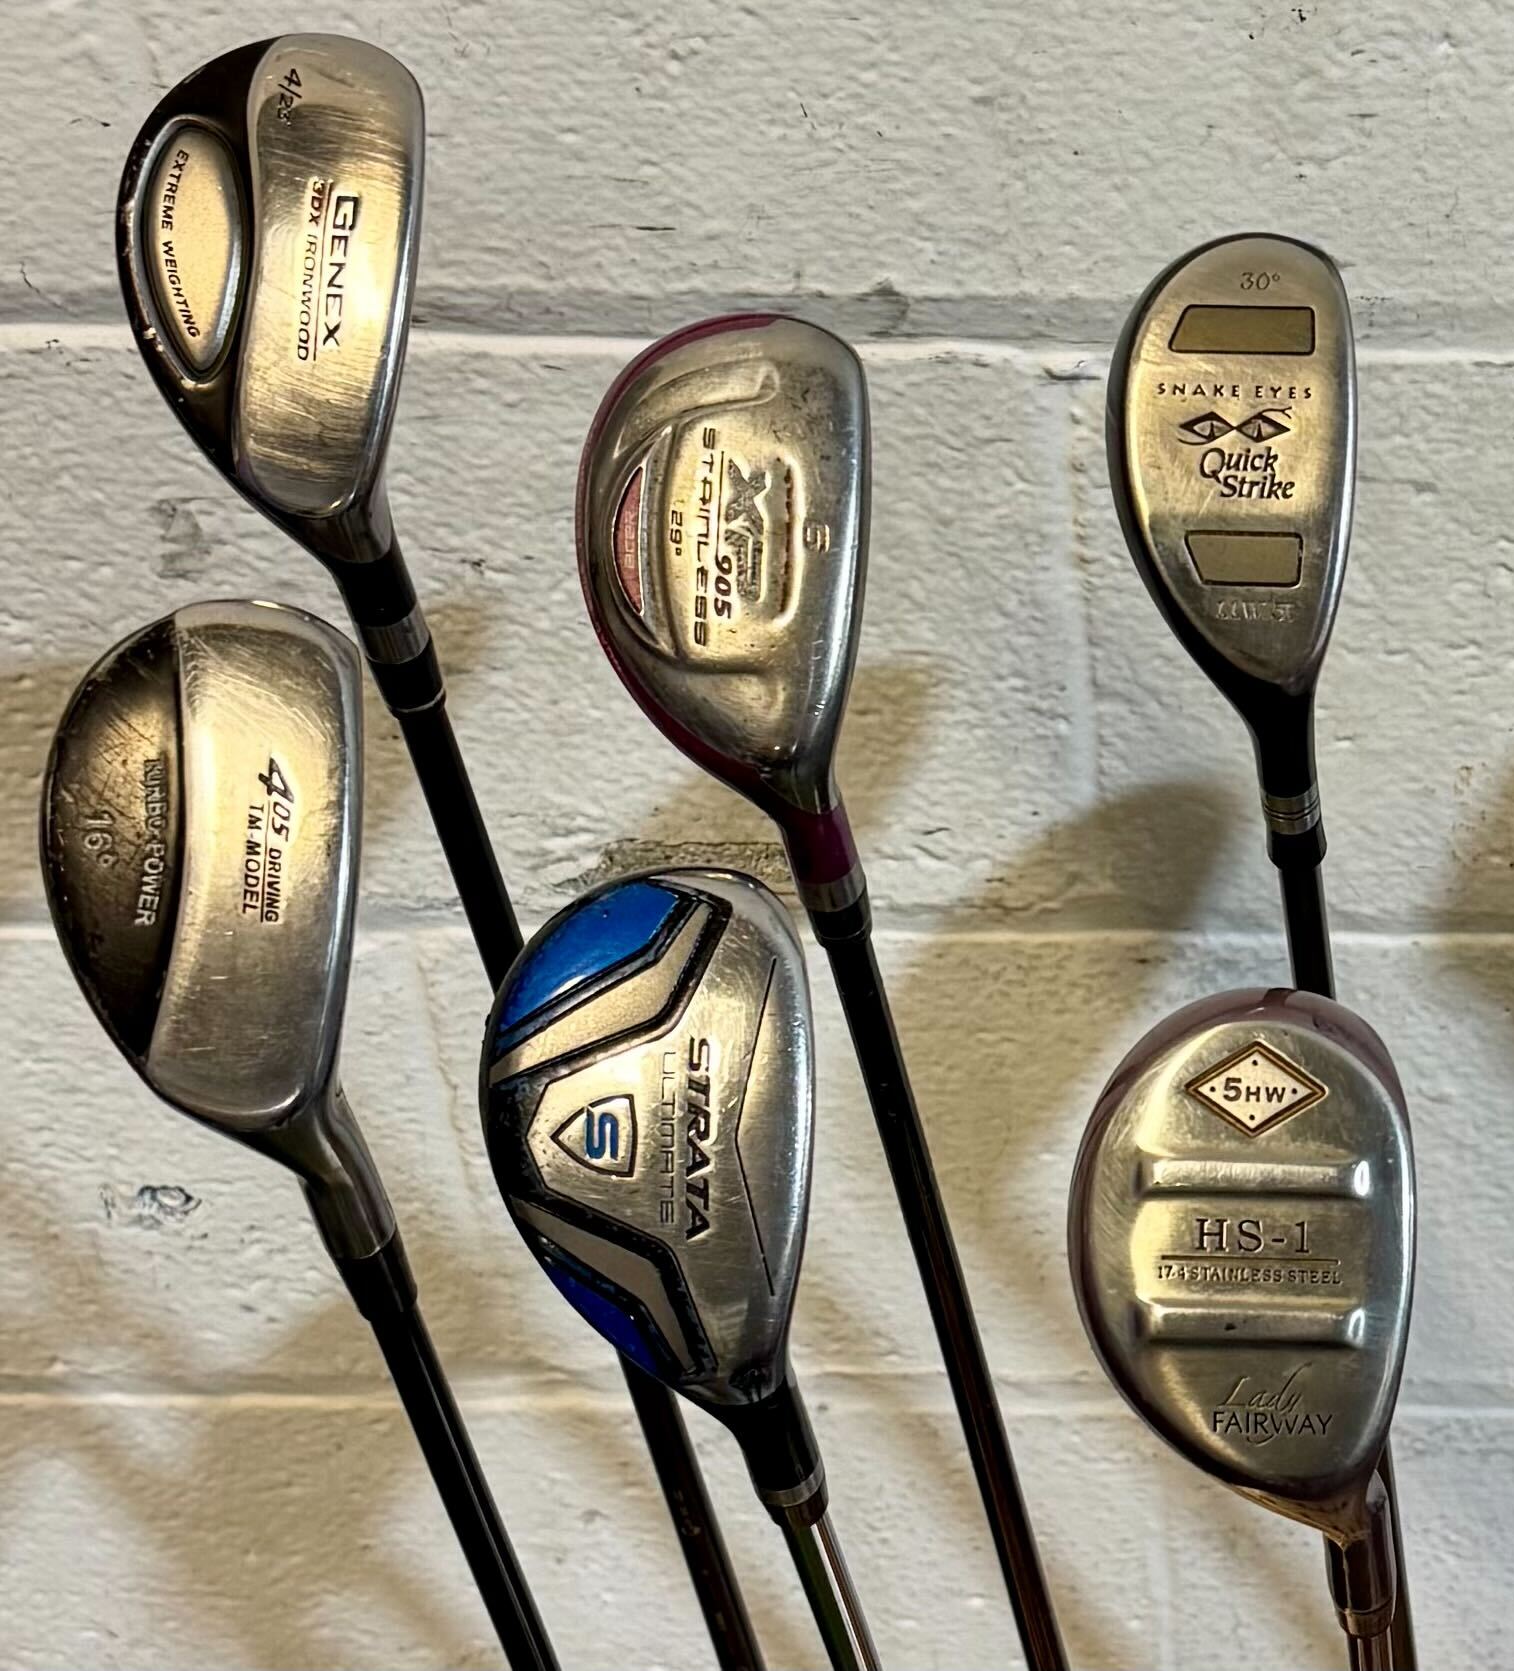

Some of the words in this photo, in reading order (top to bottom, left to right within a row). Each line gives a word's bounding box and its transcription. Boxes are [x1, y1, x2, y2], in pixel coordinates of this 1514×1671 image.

[160, 149, 190, 231] EXTREME
[307, 179, 327, 226] 3DX
[161, 243, 201, 338] WEIGHTING
[297, 233, 318, 361] IRONWOOD
[323, 194, 360, 348] GENEX
[1241, 270, 1281, 291] 30°
[1157, 382, 1242, 398] SNAKE
[1255, 384, 1314, 399] EYES
[1200, 446, 1280, 482] Quick
[1219, 475, 1296, 500] Strike
[669, 511, 684, 558] 29°
[694, 427, 716, 646] STAINLESS
[713, 554, 734, 620] 905
[258, 758, 295, 842] 405
[83, 810, 116, 867] 16°
[240, 804, 265, 915] TM-MODEL
[264, 848, 283, 923] DRIVING
[660, 1051, 676, 1223] ULTIMATE
[686, 1036, 710, 1241] STRATA
[1195, 1218, 1310, 1253] HS-1
[1288, 1269, 1342, 1285] STEEL
[1212, 1411, 1333, 1436] FAIRWAY
